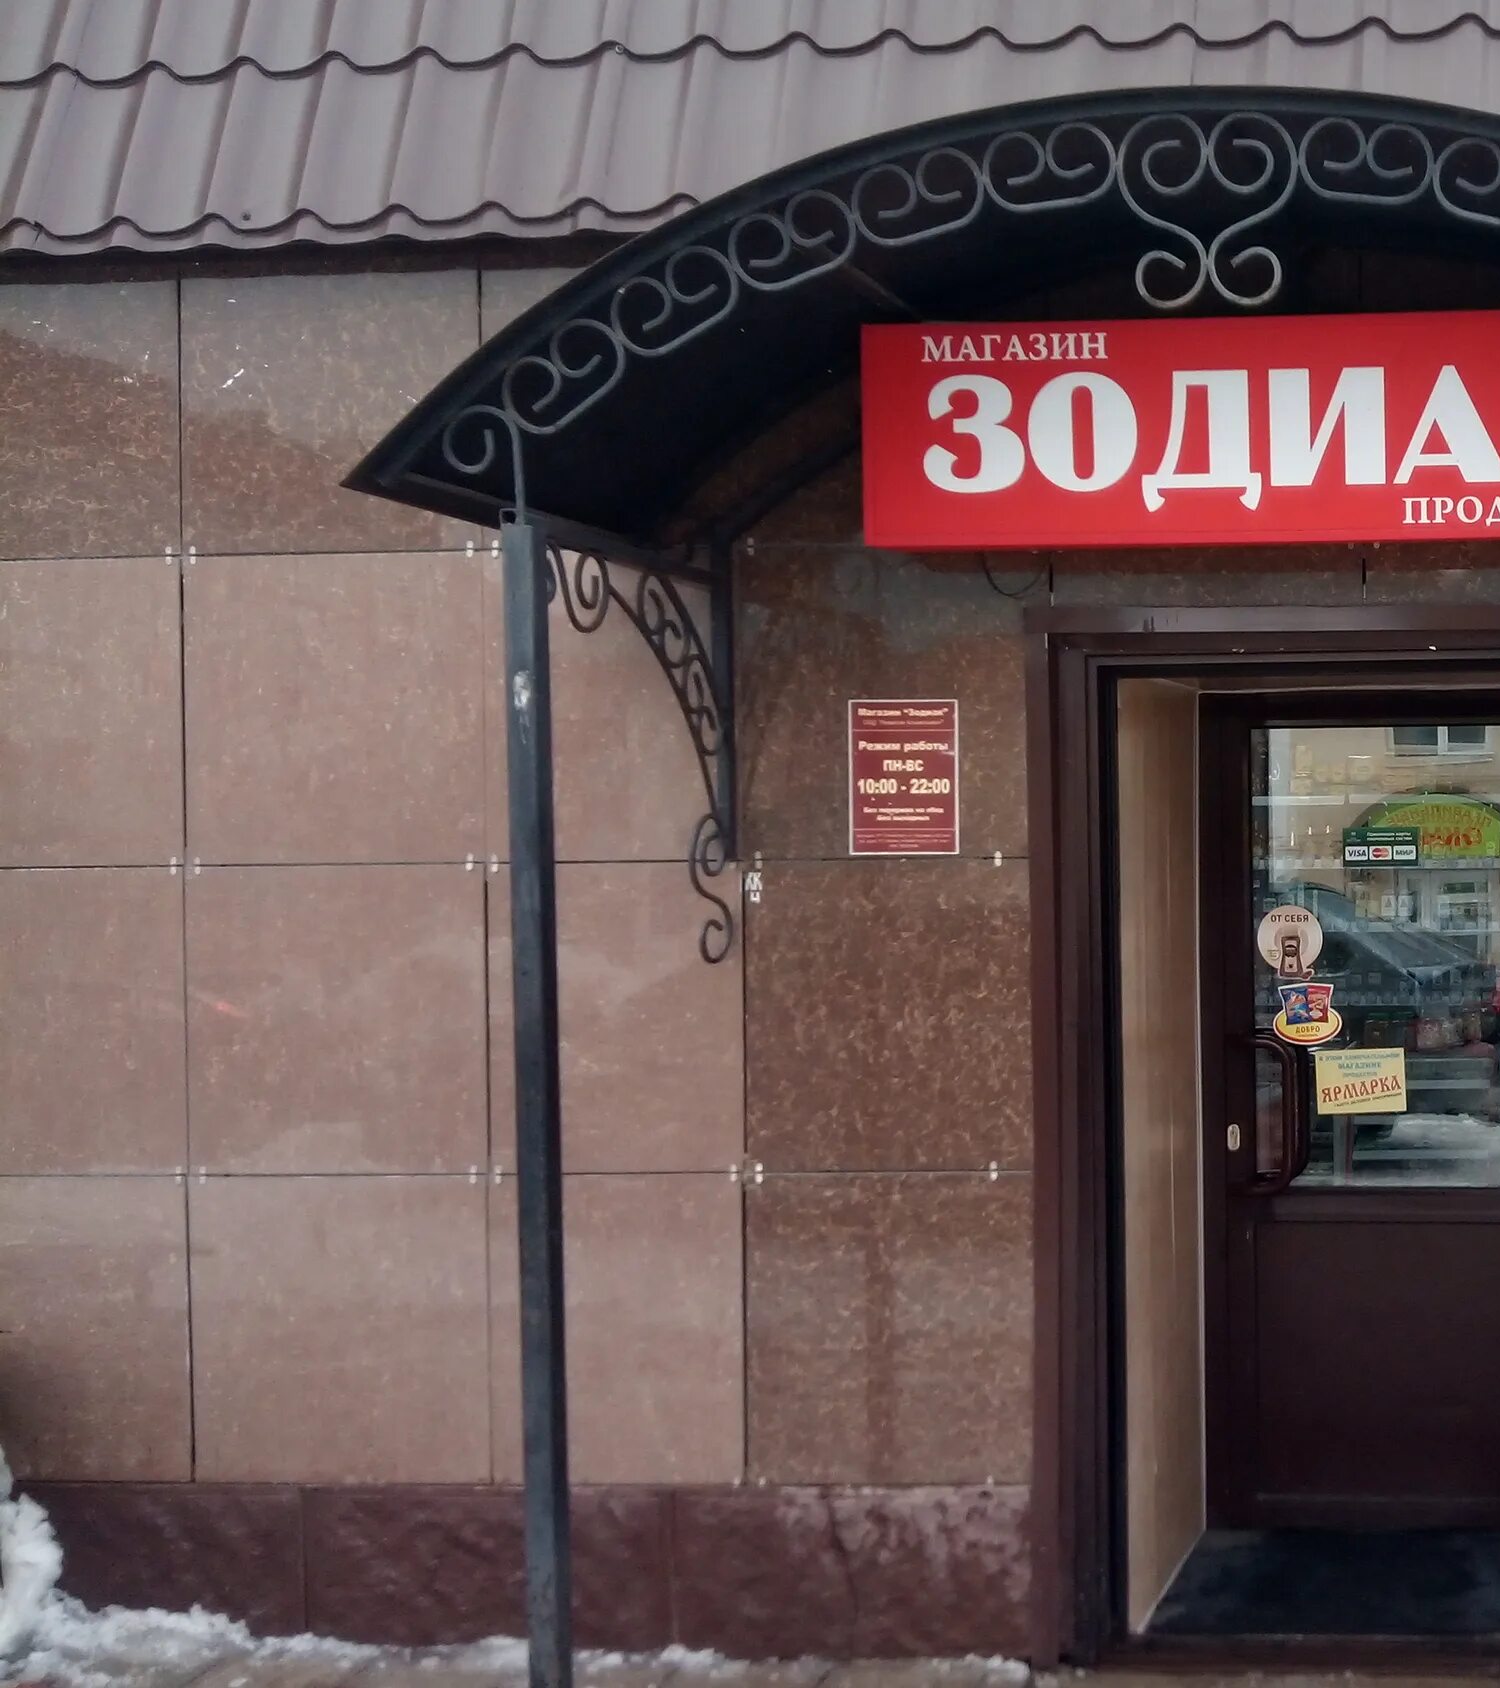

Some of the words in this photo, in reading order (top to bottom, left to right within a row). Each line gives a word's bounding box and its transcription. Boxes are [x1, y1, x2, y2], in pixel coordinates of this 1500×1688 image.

[921, 332, 1109, 363] МАГАЗИН
[858, 741, 901, 751] Режим
[903, 740, 949, 753] работы
[882, 760, 925, 772] ПН-ВС
[857, 778, 898, 794] 10:00
[909, 778, 951, 794] 22:00
[1348, 849, 1367, 857] VISA
[1270, 914, 1282, 923] ОТ
[1284, 914, 1309, 923] СЕБЯ
[1295, 1025, 1321, 1034] ДОБРО
[1321, 1075, 1402, 1104] ЯРМАРКА
